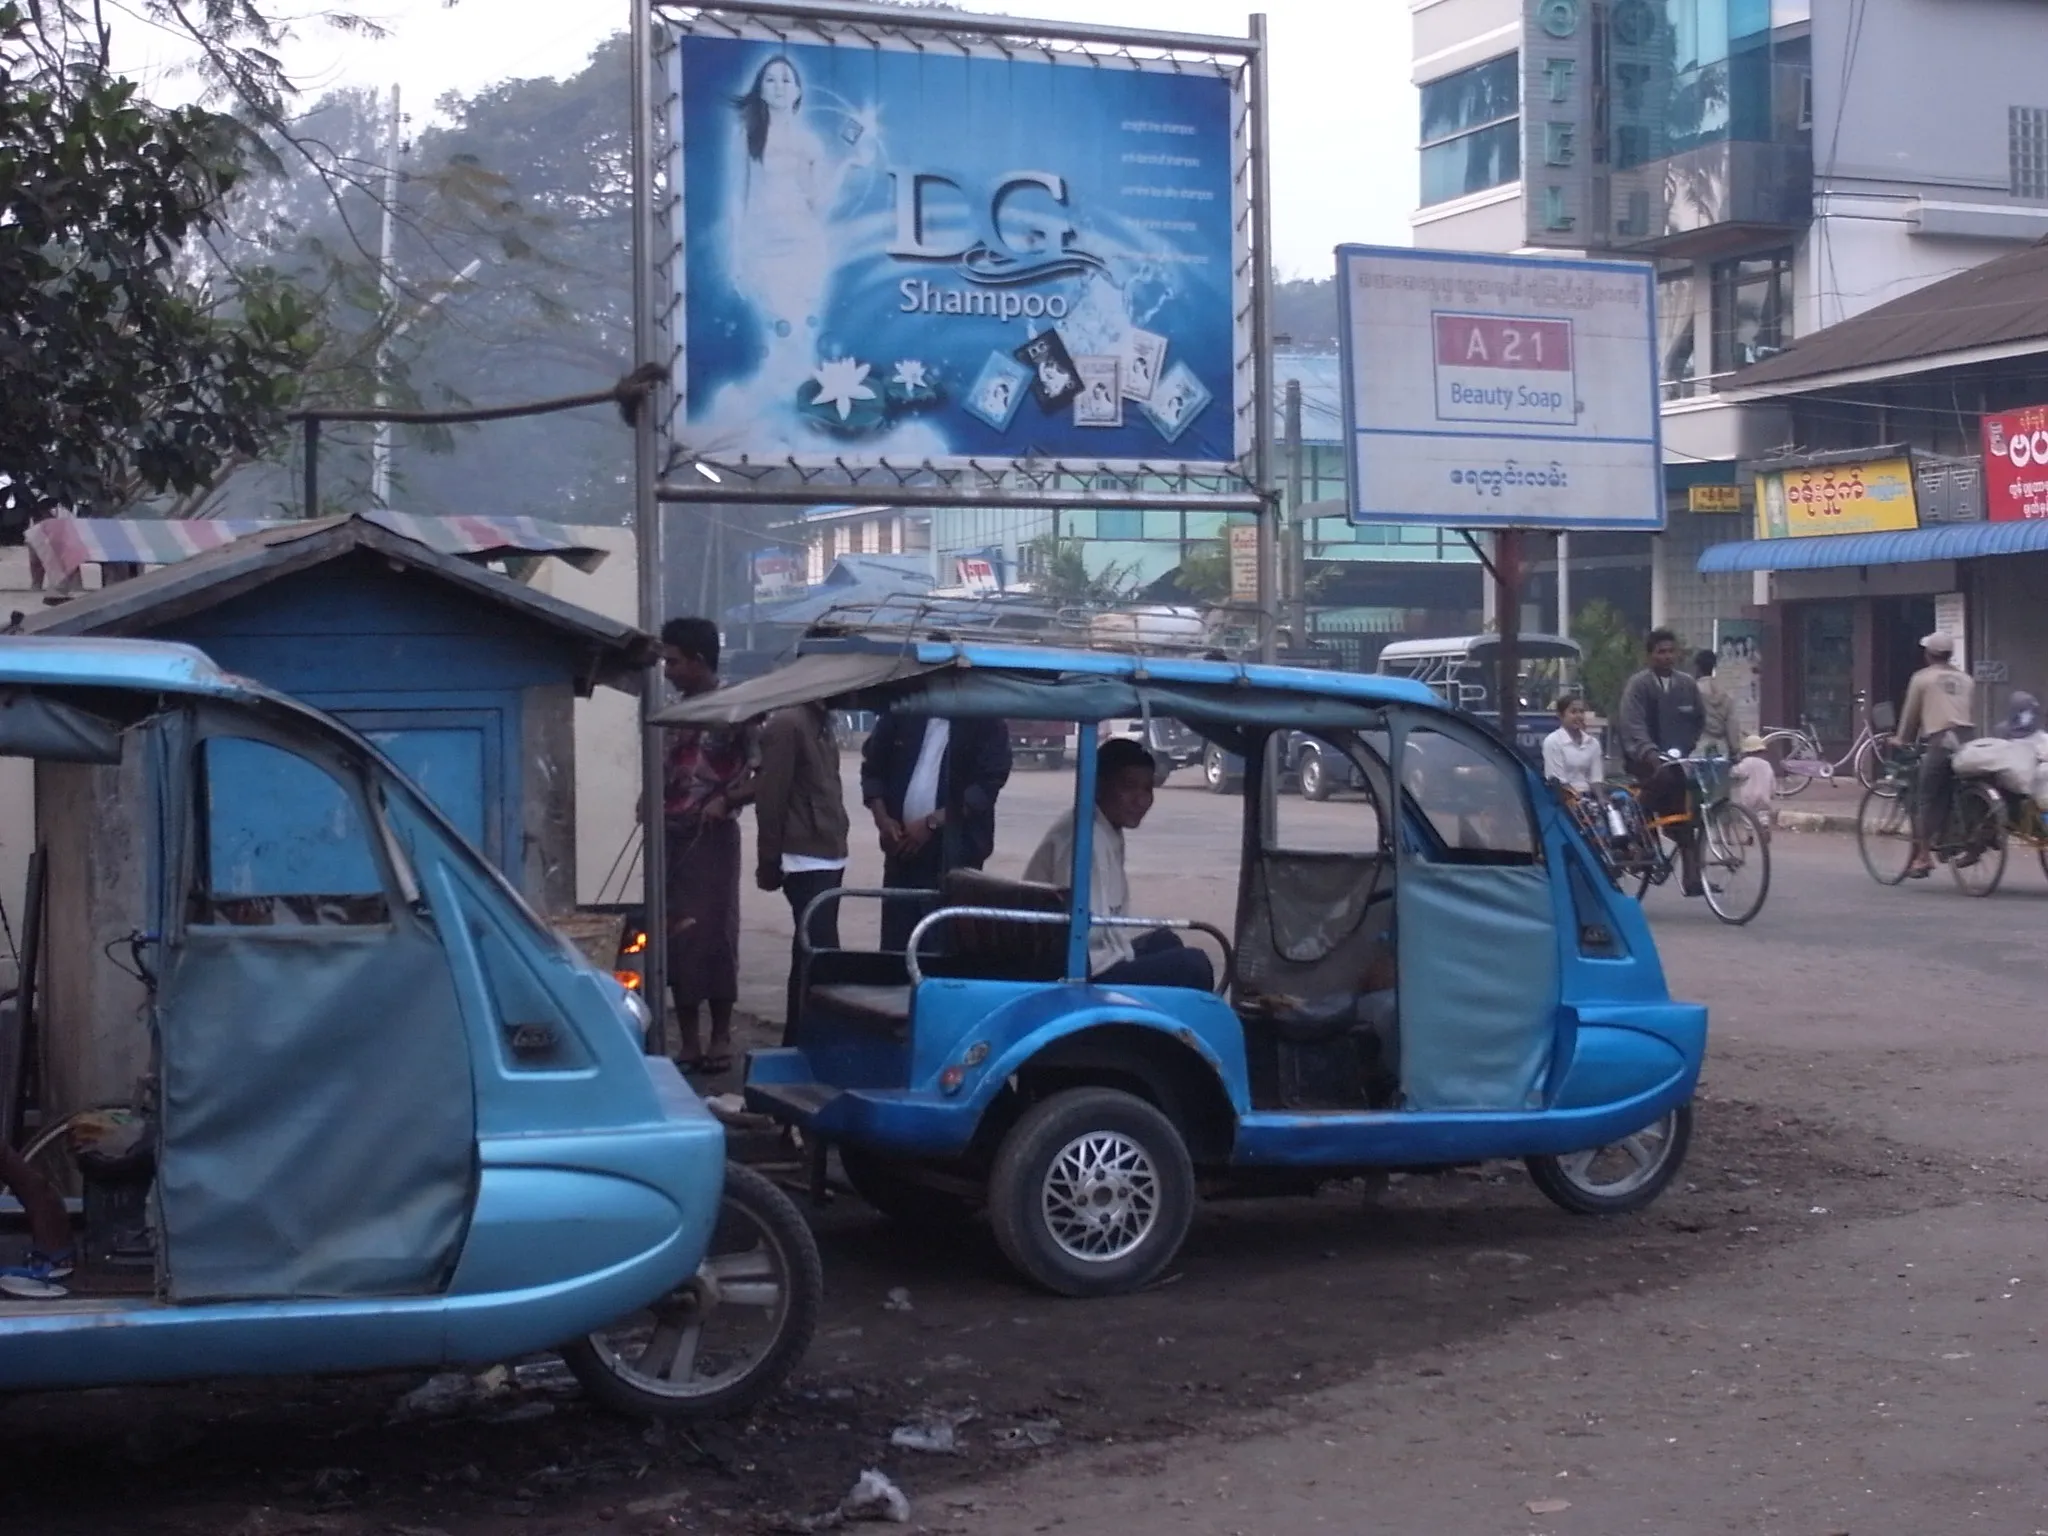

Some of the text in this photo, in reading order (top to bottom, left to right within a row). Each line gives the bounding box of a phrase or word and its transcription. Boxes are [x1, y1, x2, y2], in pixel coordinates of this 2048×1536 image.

[886, 171, 1077, 260] DG
[899, 278, 1069, 321] Shampoo
[1465, 327, 1543, 363] A 21
[1450, 382, 1562, 411] Beauty Soap
